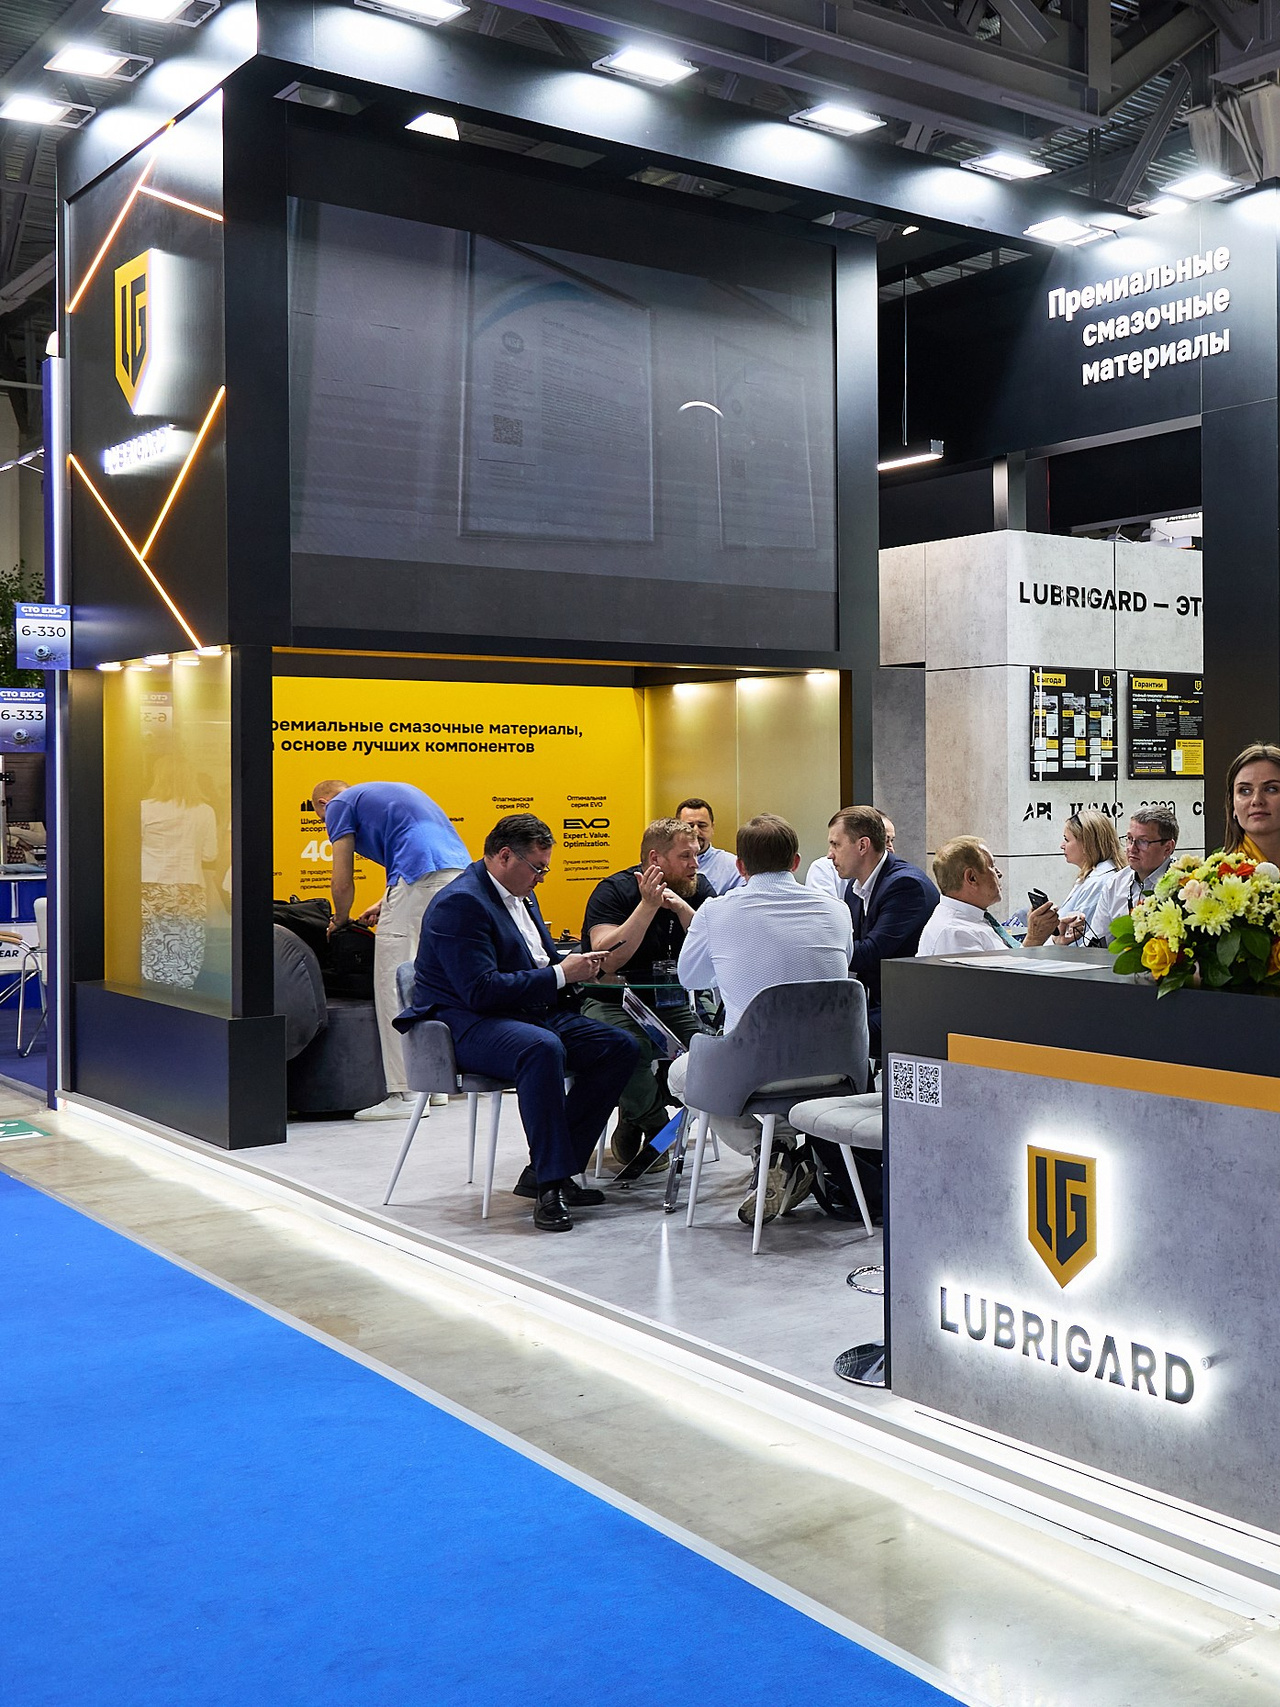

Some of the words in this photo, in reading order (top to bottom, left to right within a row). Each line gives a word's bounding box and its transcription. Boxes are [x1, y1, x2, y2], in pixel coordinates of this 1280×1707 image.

[1047, 246, 1230, 321] Премиальные
[1081, 287, 1230, 347] смазочные
[1081, 328, 1230, 386] материалы
[1019, 582, 1147, 612] LUBRIGARD
[1176, 596, 1204, 617] ЭТ
[21, 625, 67, 638] 6-330
[1134, 681, 1164, 689] Гарантии
[1, 709, 44, 721] 6-333
[389, 721, 484, 735] смазочные
[489, 722, 583, 737] материалы,
[280, 739, 347, 752] основе
[352, 739, 421, 755] лучших
[425, 740, 535, 754] компонентов
[563, 818, 610, 829] EVO
[563, 832, 588, 840] Expert.
[563, 840, 610, 848] Optimization.
[940, 1286, 1195, 1404] LUBRIGARD
